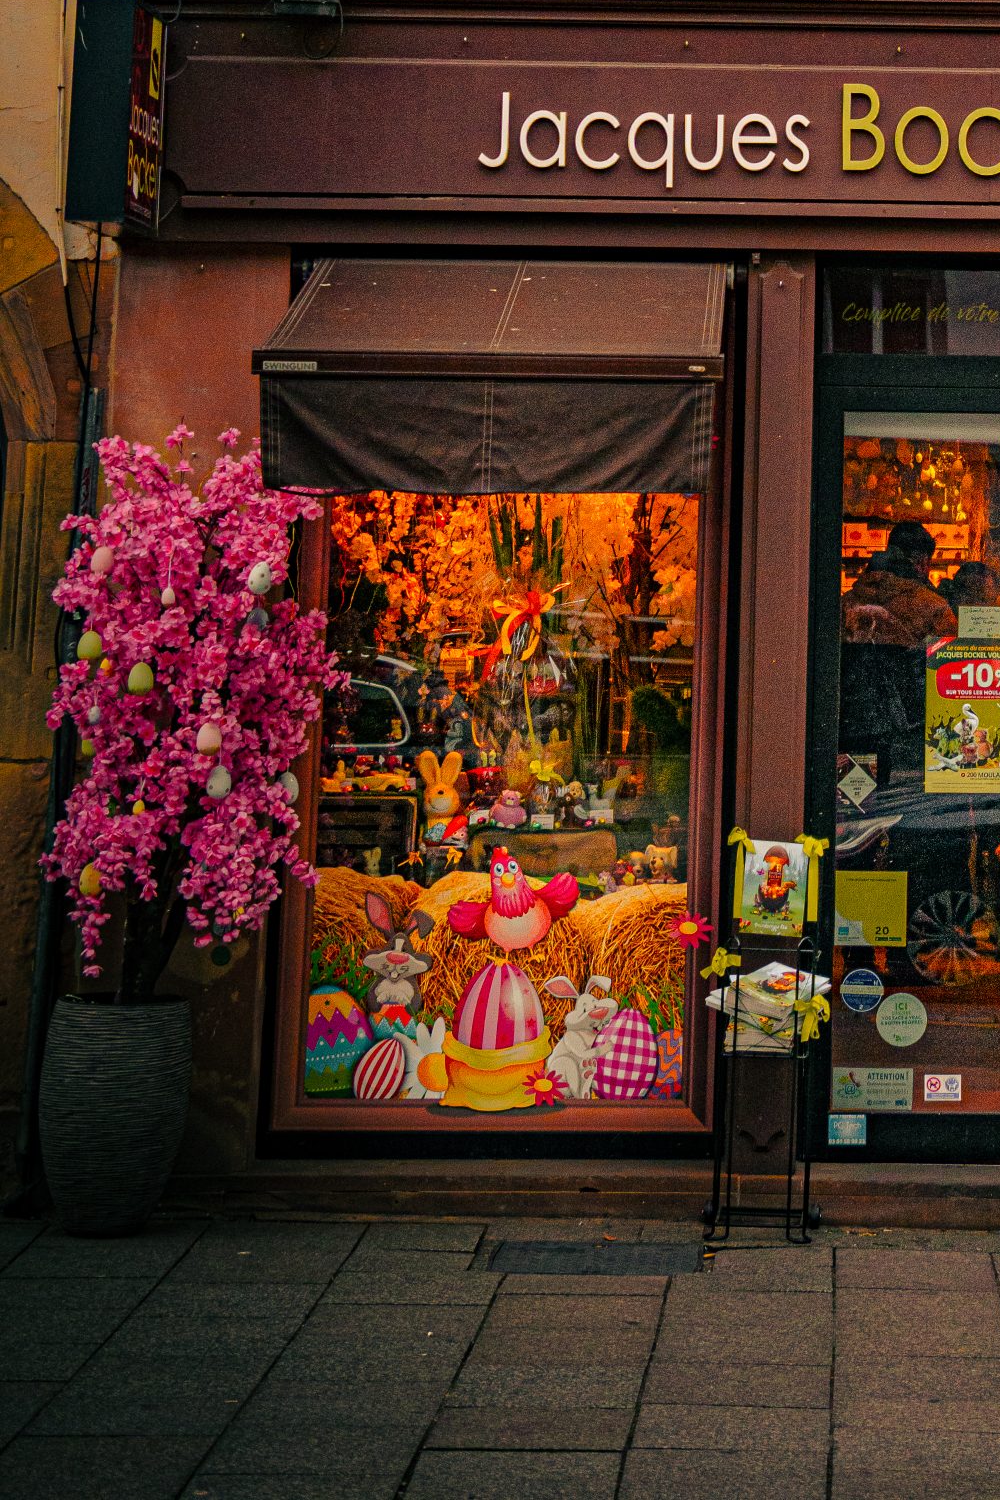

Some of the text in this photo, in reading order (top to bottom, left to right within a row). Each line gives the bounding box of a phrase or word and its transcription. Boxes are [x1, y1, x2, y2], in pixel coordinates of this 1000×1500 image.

[478, 91, 811, 188] Jacques
[841, 301, 921, 330] Complice
[927, 301, 950, 323] de
[956, 302, 1000, 324] votre
[264, 362, 316, 370] SWINGLINE
[936, 652, 963, 660] JACQUES
[867, 1072, 905, 1080] ATTENTION
